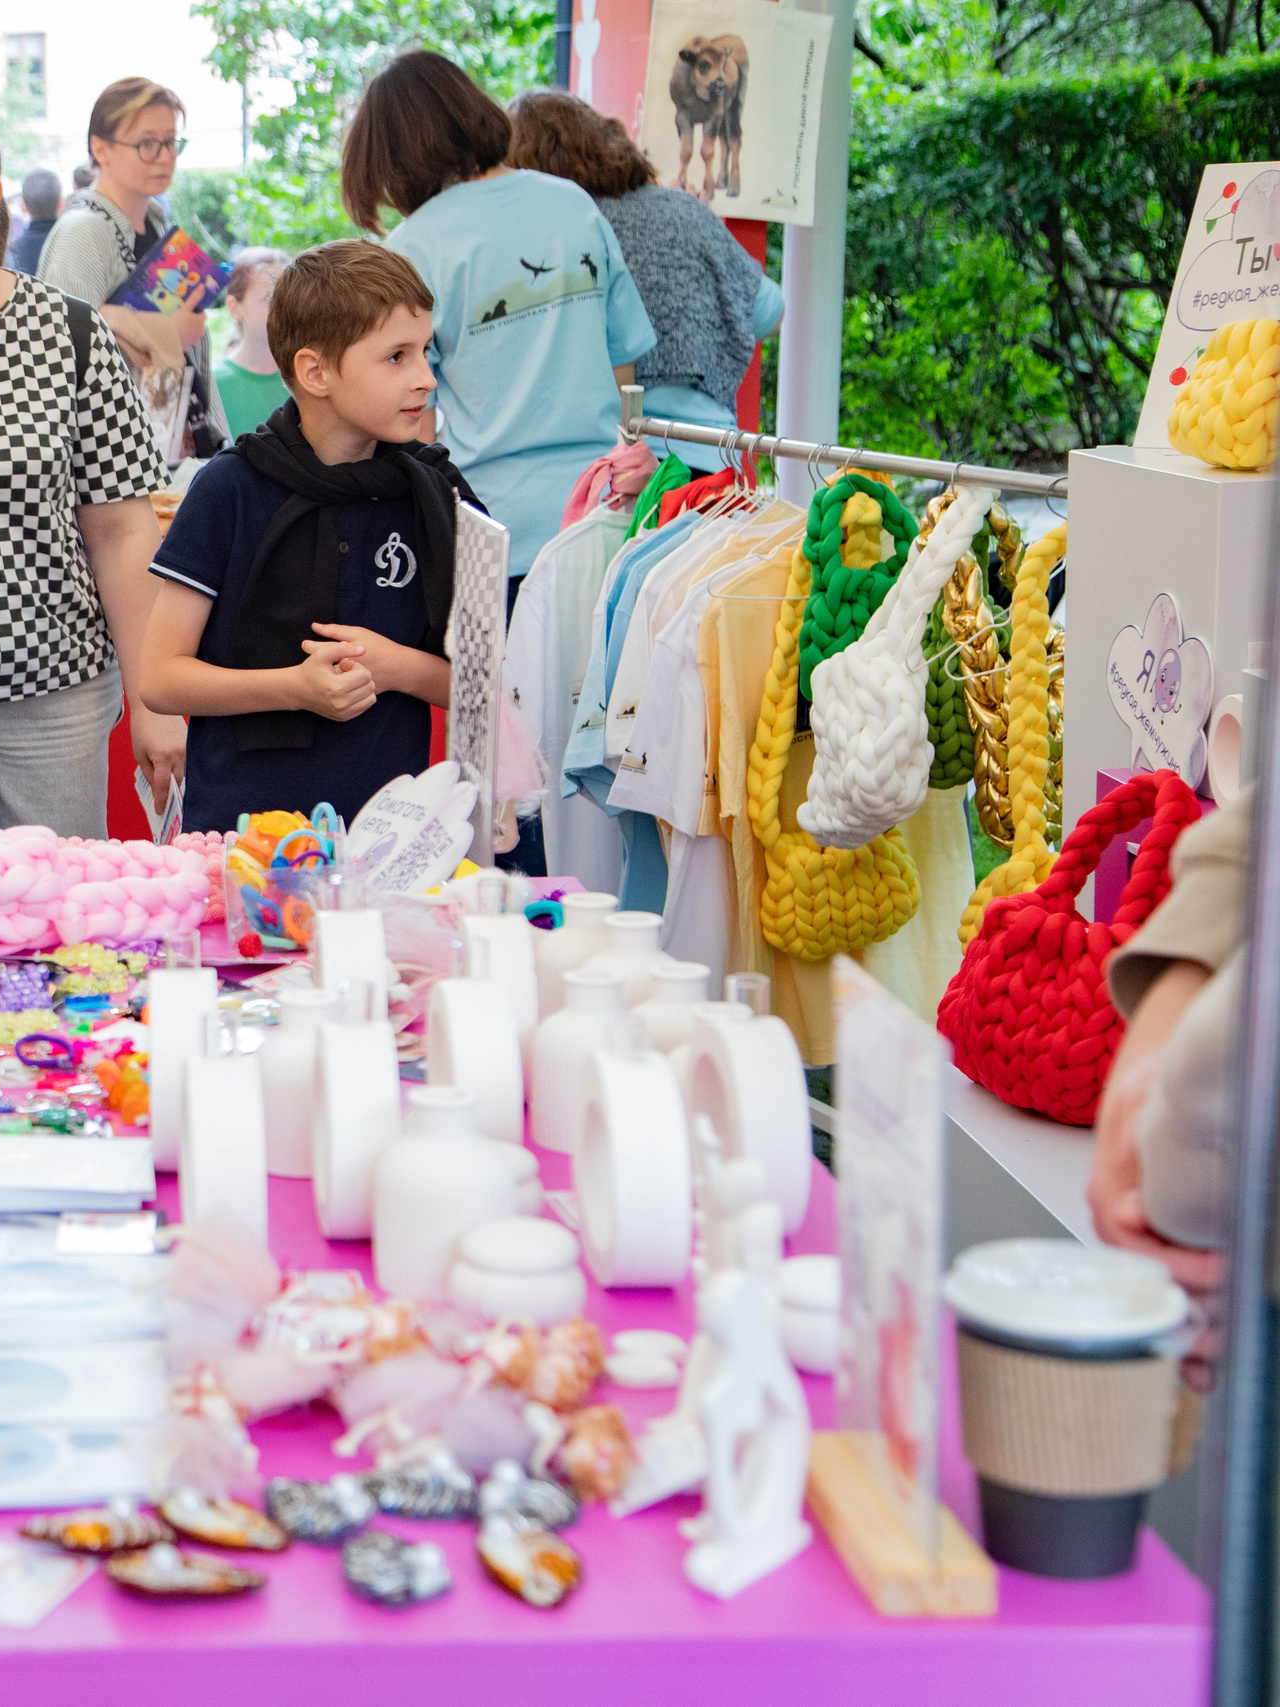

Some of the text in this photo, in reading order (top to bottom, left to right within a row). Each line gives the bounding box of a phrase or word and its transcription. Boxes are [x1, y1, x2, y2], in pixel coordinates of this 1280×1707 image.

[1236, 236, 1272, 275] Ты
[1192, 283, 1280, 312] #редкая_же
[1136, 649, 1156, 694] Я
[371, 789, 429, 822] Помогать
[357, 815, 393, 835] легко
